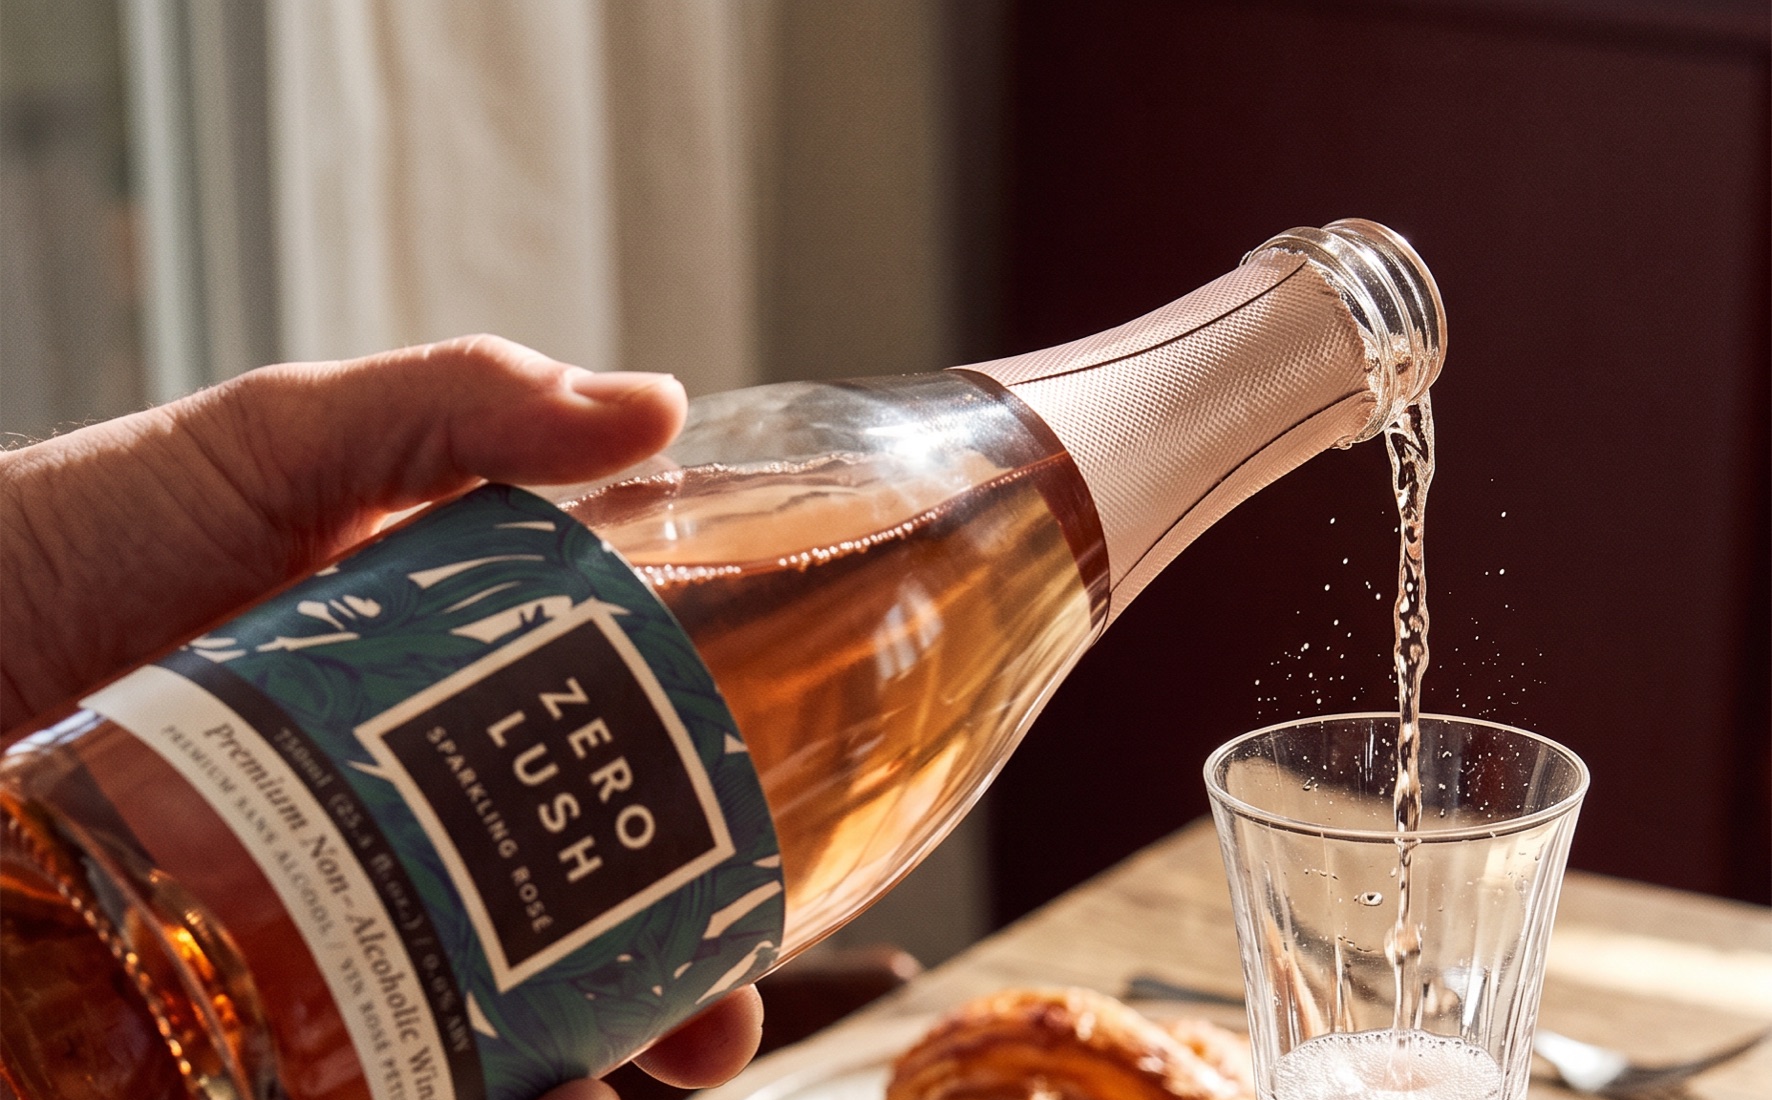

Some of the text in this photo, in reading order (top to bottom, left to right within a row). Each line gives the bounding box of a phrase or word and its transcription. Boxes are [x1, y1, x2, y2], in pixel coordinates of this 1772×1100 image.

[203, 723, 310, 833] Premium
[426, 726, 553, 932] SPARKLING ROSÉ
[487, 710, 602, 882] LUSH
[538, 677, 656, 849] ZERO
